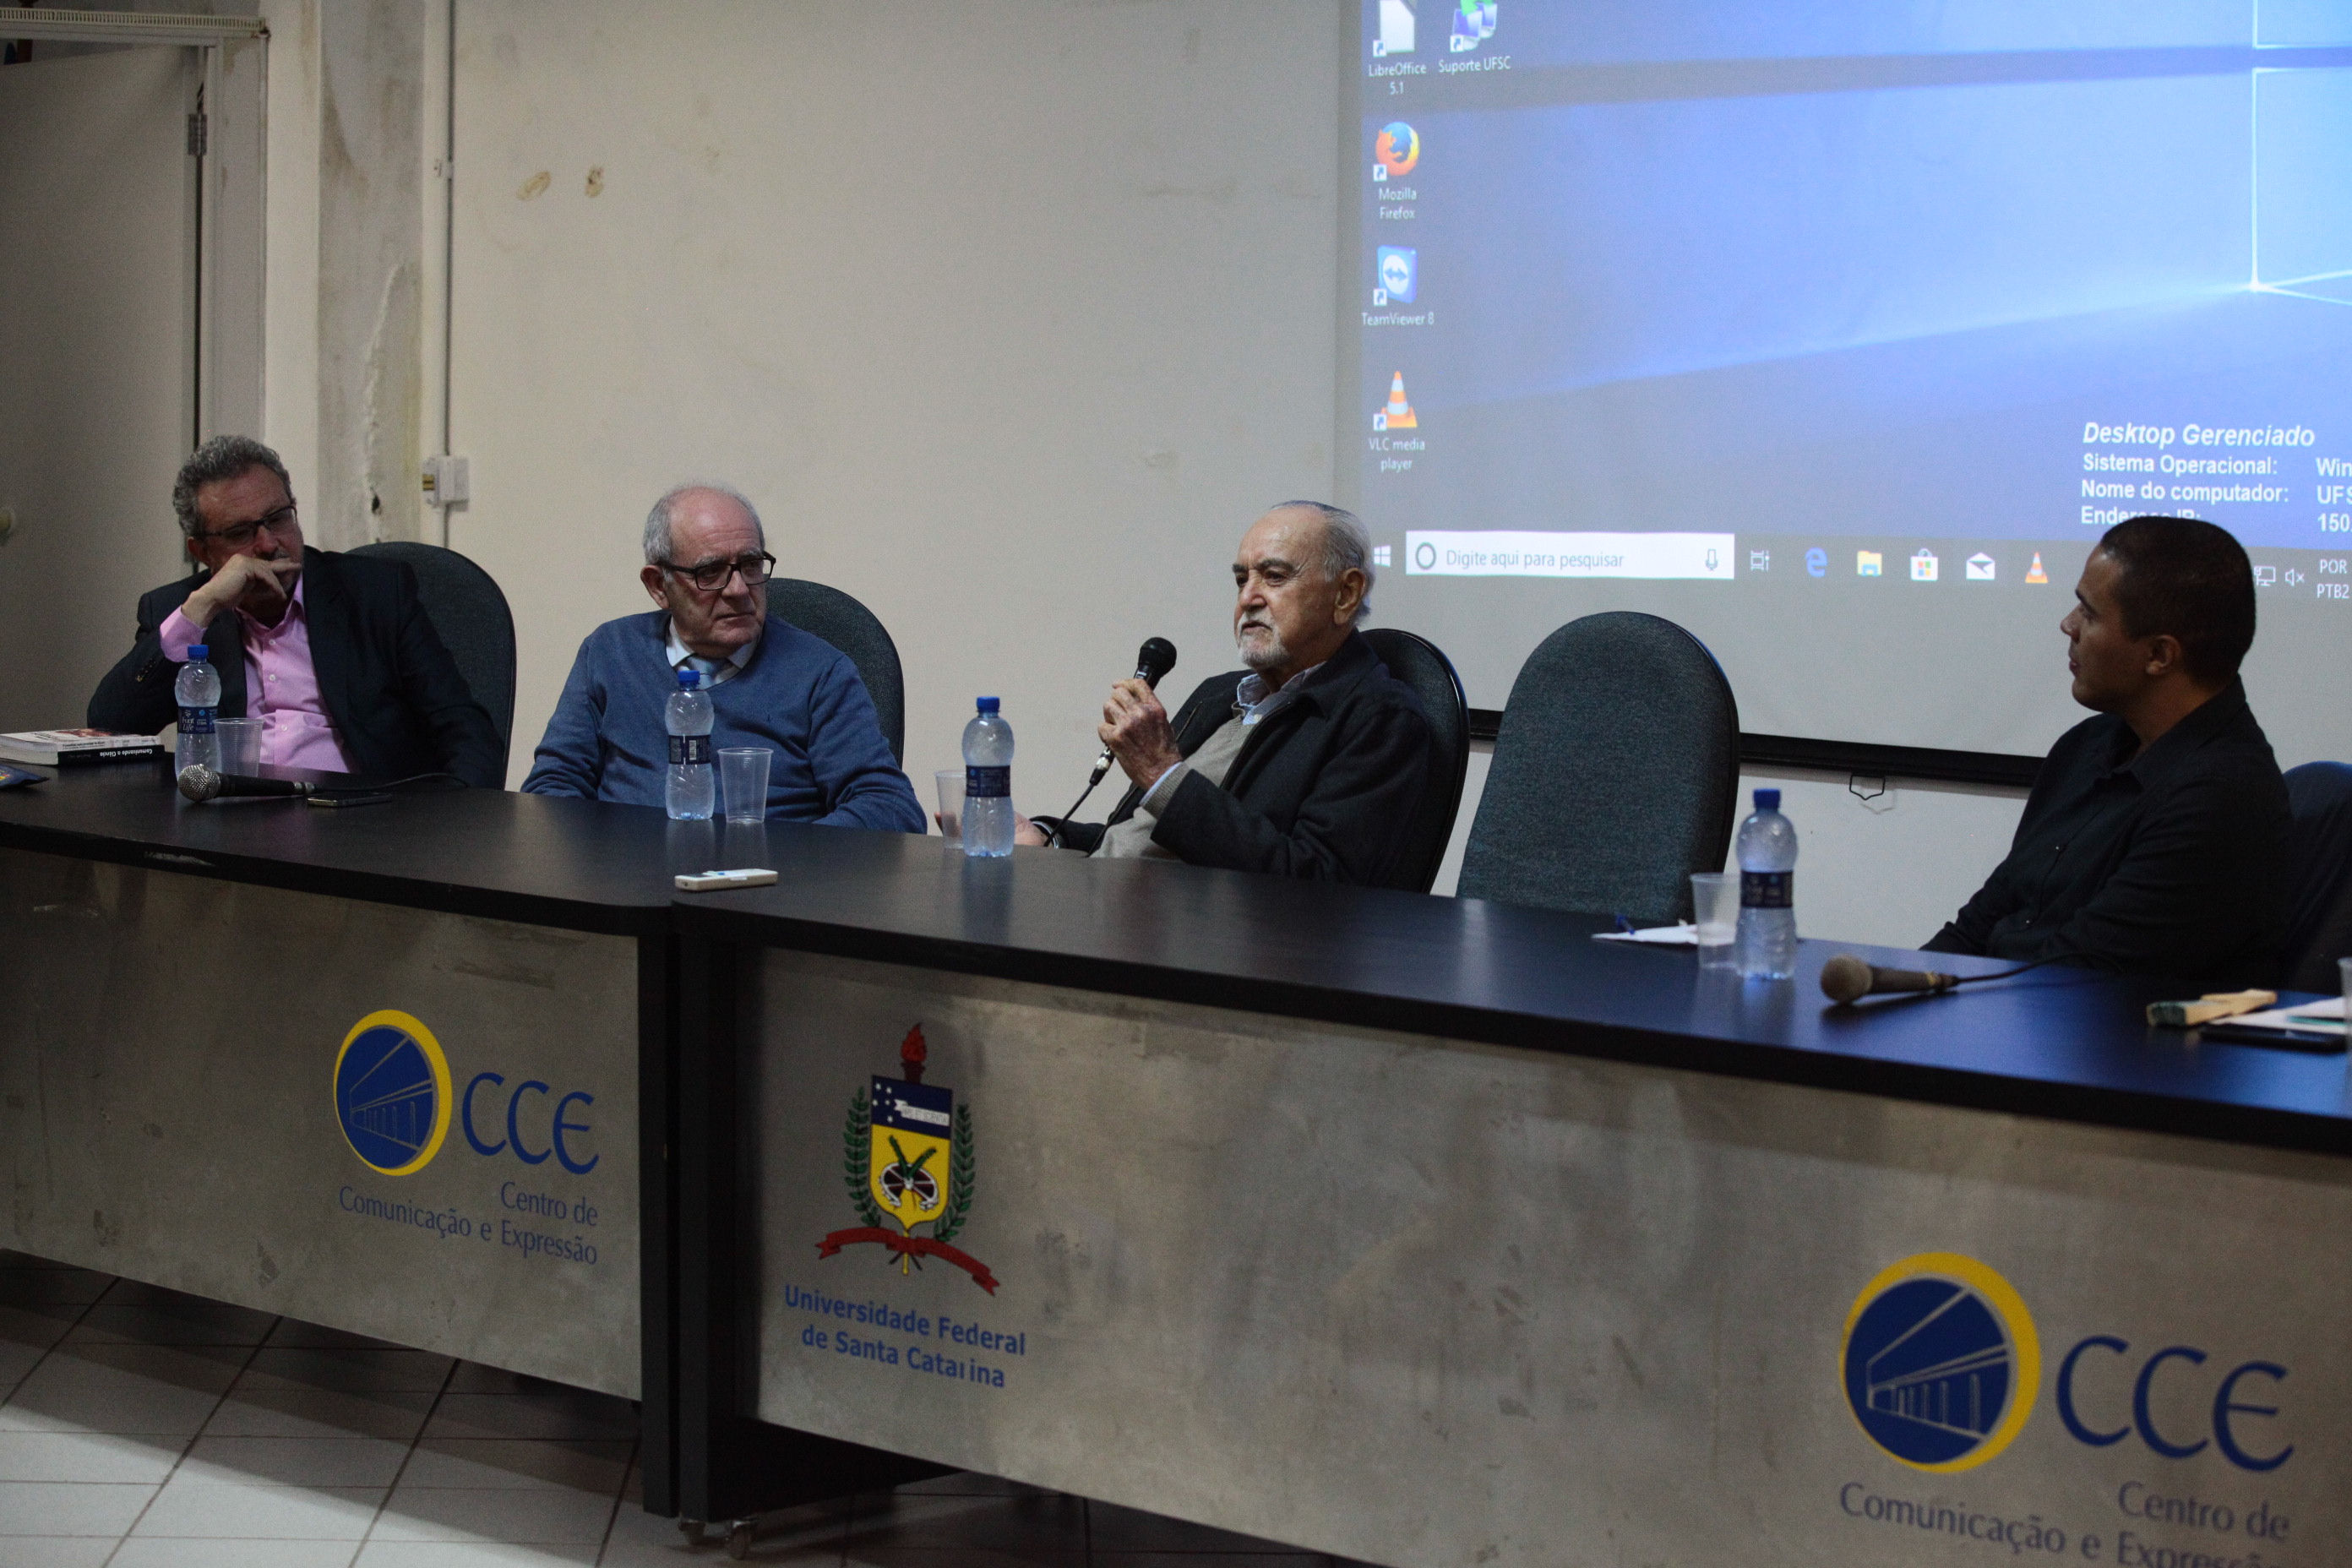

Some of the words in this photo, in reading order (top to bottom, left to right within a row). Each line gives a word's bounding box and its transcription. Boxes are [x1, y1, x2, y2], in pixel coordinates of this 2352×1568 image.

[1369, 63, 1427, 77] LibreOffice
[1439, 60, 1481, 75] Suporte
[1484, 57, 1511, 70] UFSC
[1390, 82, 1404, 95] 5.1
[1379, 188, 1417, 201] Mozilla
[1380, 207, 1415, 220] Firefox
[1362, 312, 1425, 326] TeamViewer
[1369, 438, 1390, 450] VLC
[1393, 438, 1425, 450] media
[2082, 422, 2175, 449] Desktop
[2182, 424, 2316, 447] Gerenciado
[1380, 459, 1413, 473] player
[2083, 453, 2155, 473] Sistema
[2160, 455, 2278, 477] Operacional:
[2081, 479, 2135, 499] Nome
[2141, 482, 2166, 500] do
[2170, 483, 2289, 505] computador:
[1446, 549, 1487, 569] Digite
[1490, 550, 1519, 569] aqui
[1524, 553, 1554, 569] para
[1560, 552, 1624, 571] pesquisar
[2319, 558, 2347, 574] POR
[2317, 584, 2349, 599] PTB2
[461, 1071, 600, 1175] CCE
[501, 1181, 567, 1220] Centro
[574, 1196, 598, 1227] de
[340, 1185, 471, 1239] Comunicação
[480, 1222, 493, 1242] e
[501, 1219, 598, 1266] Expressão
[784, 1284, 930, 1337] Universidade
[938, 1317, 1026, 1356] Federal
[801, 1324, 828, 1350] de
[836, 1331, 900, 1365] Santa
[2055, 1334, 2295, 1473] CCE
[1839, 1481, 2067, 1555] Comunicação
[2081, 1530, 2102, 1560] e
[2117, 1480, 2236, 1533] Centro
[2246, 1502, 2290, 1542] de
